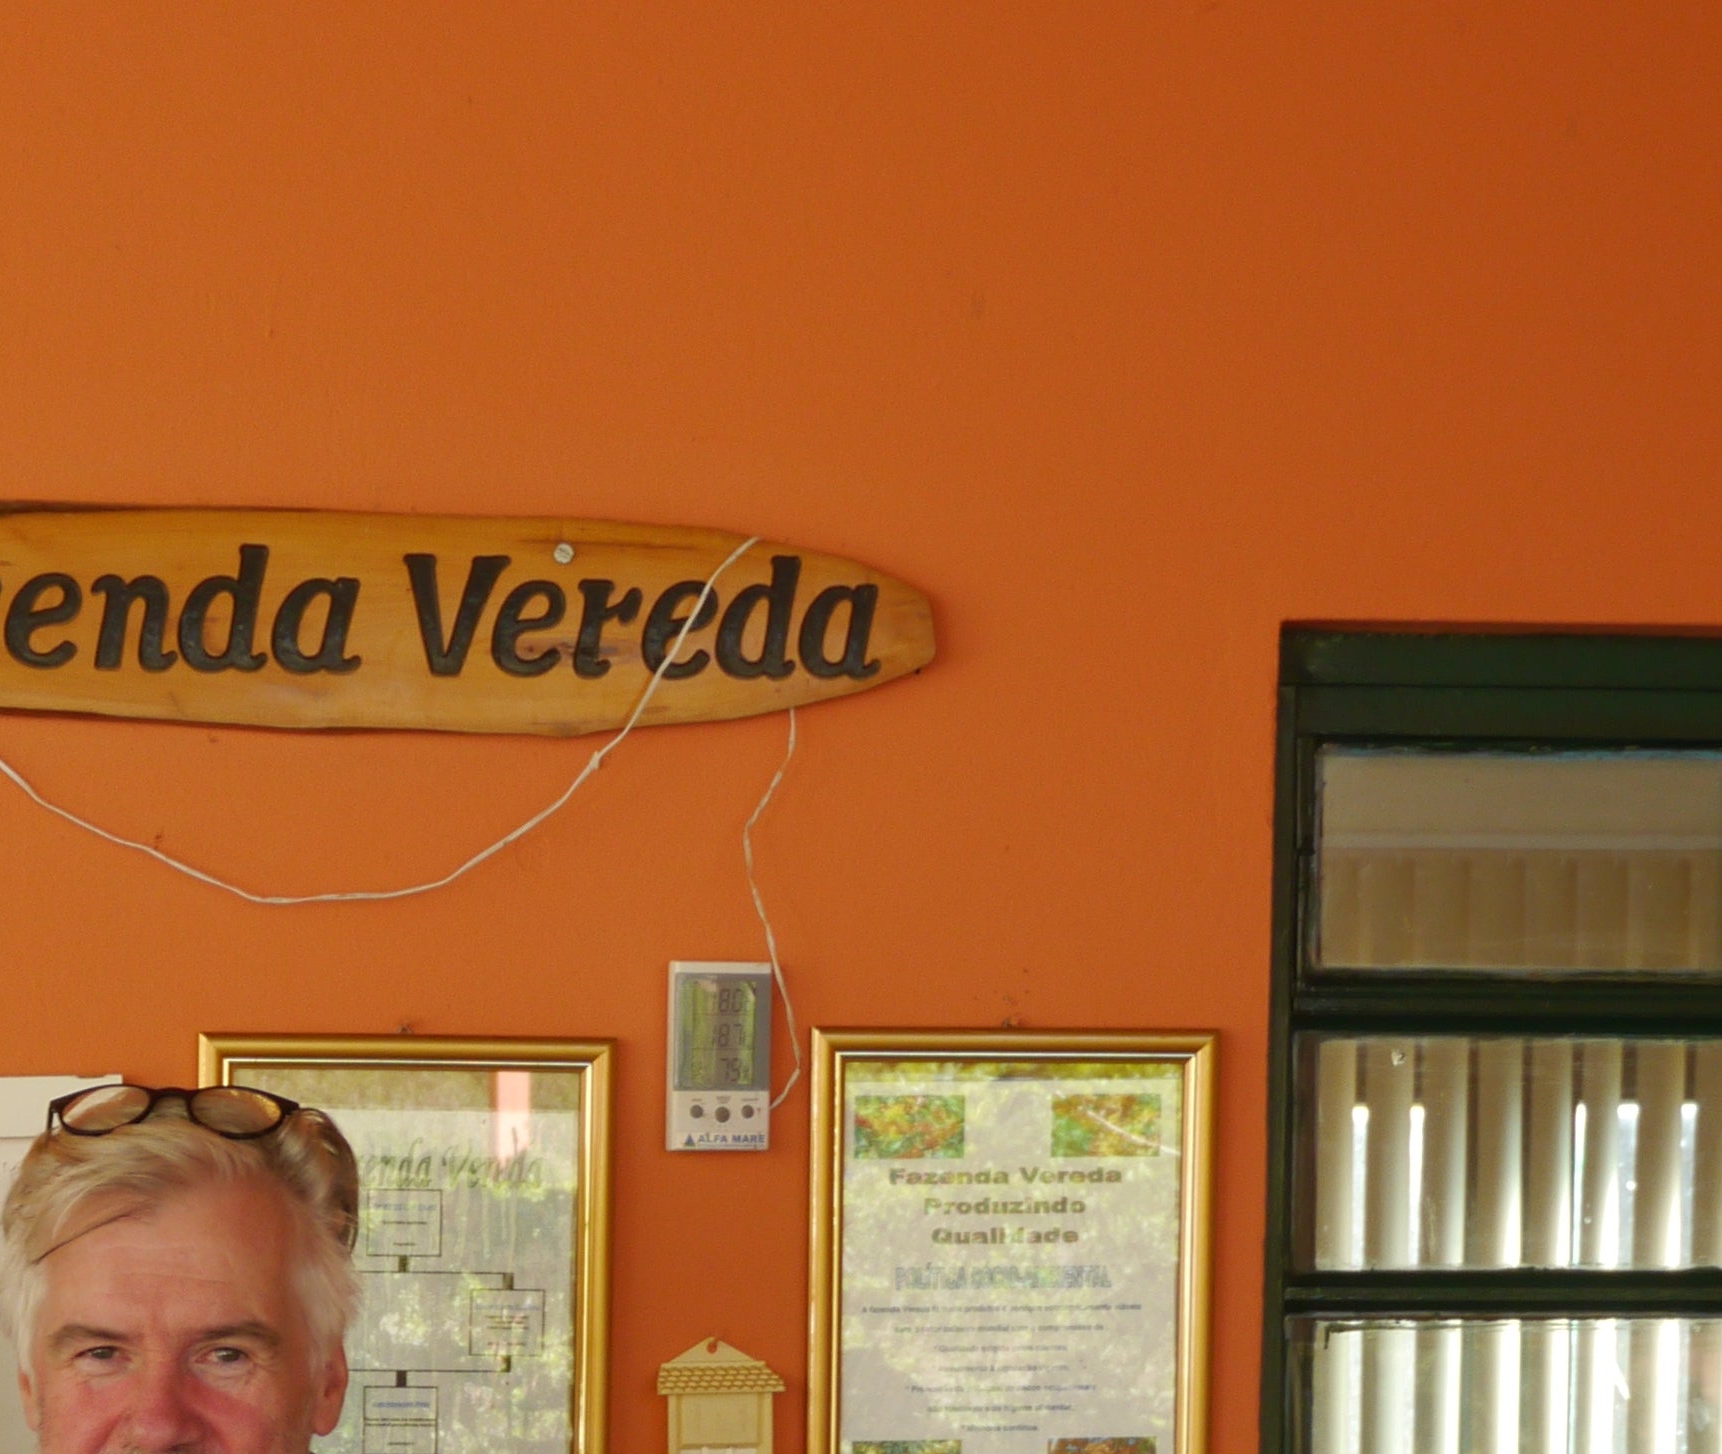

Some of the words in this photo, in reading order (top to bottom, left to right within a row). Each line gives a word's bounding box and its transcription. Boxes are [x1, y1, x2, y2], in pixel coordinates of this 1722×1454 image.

[404, 553, 880, 681] Vereda
[889, 1168, 1010, 1185] Fazenda
[1019, 1166, 1122, 1184] Vereda
[924, 1197, 1087, 1216] Produzindo
